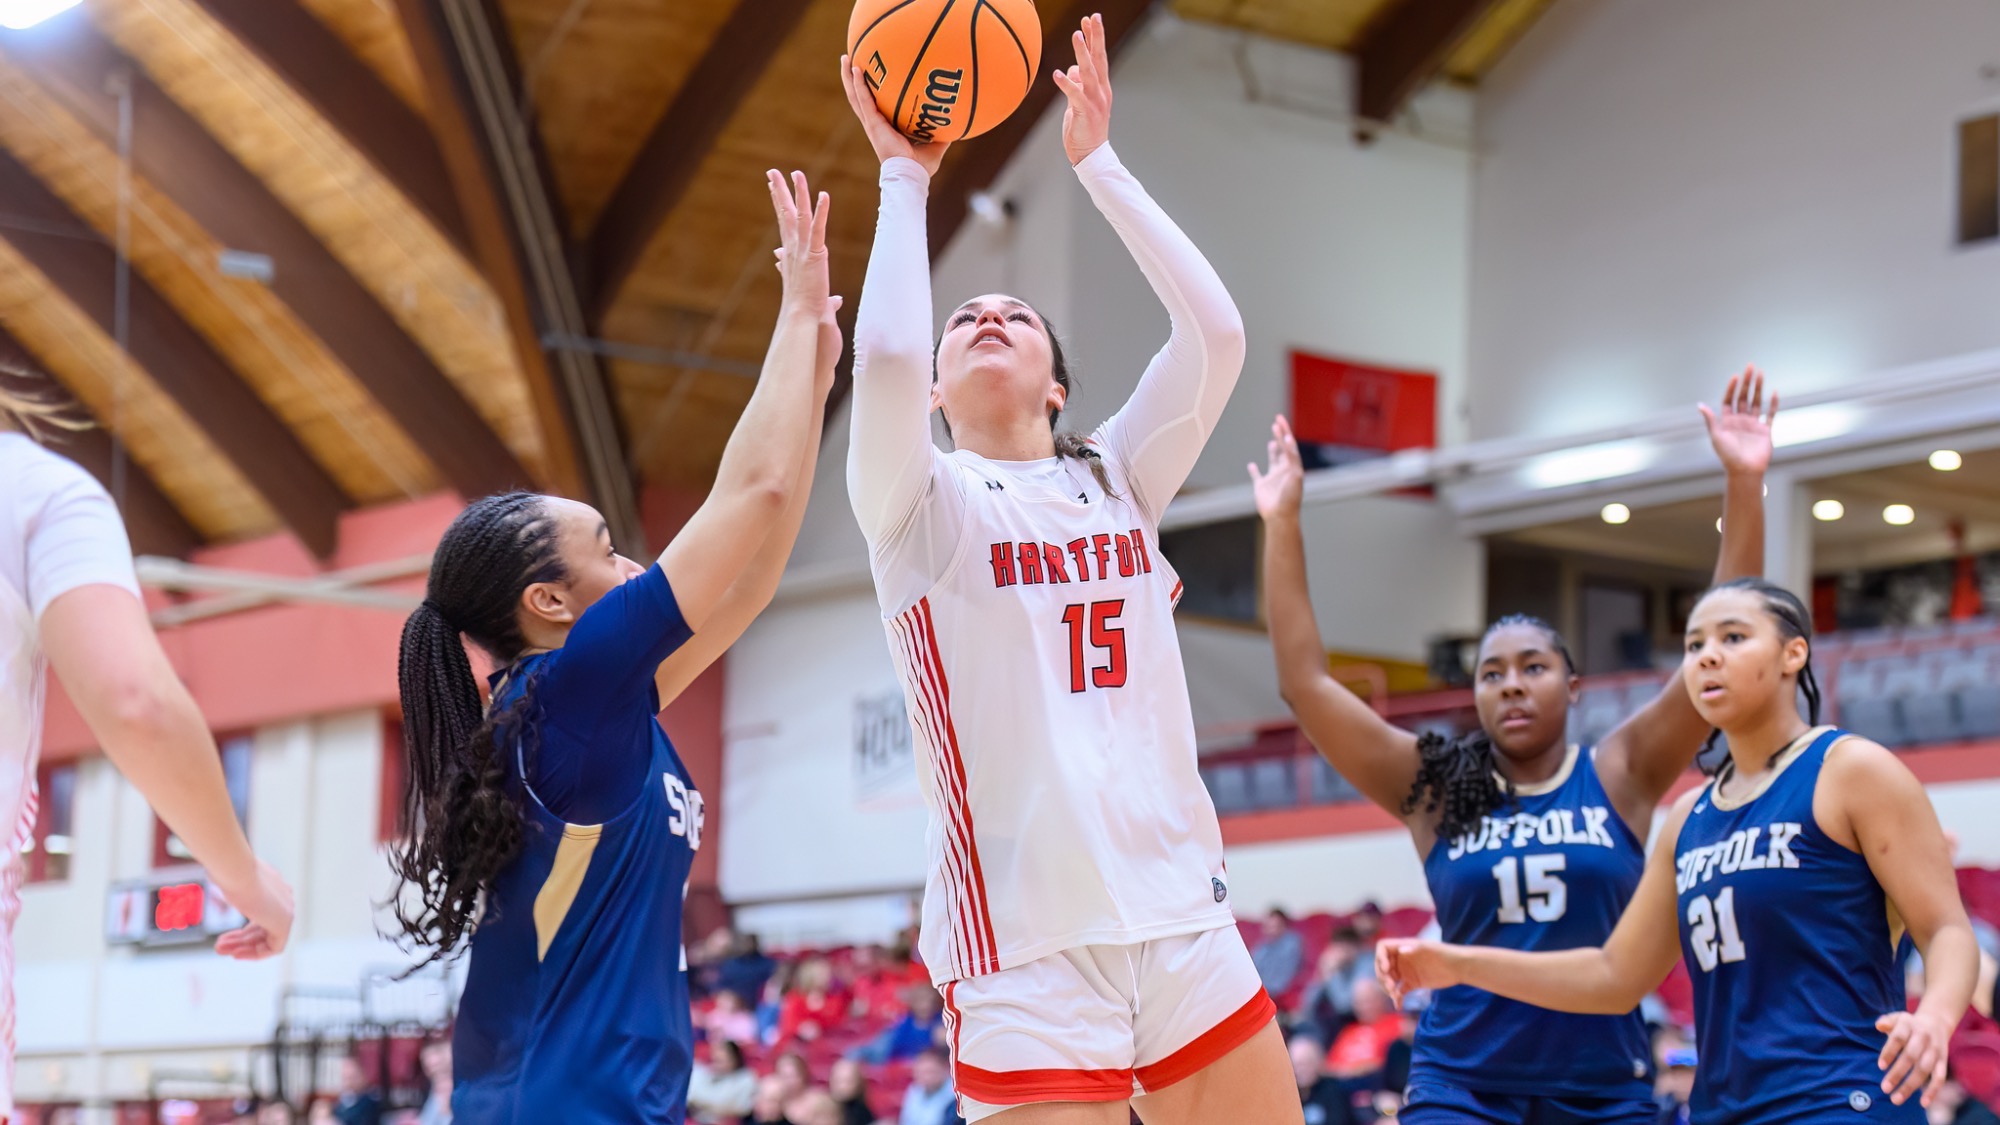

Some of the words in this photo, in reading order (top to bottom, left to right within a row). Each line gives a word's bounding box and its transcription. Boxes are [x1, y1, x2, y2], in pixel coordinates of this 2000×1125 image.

[989, 529, 1152, 588] HARTFO
[1061, 599, 1126, 693] 15
[1492, 853, 1567, 924] 15
[1676, 822, 1802, 895] UFFOLK
[1687, 886, 1746, 973] 21
